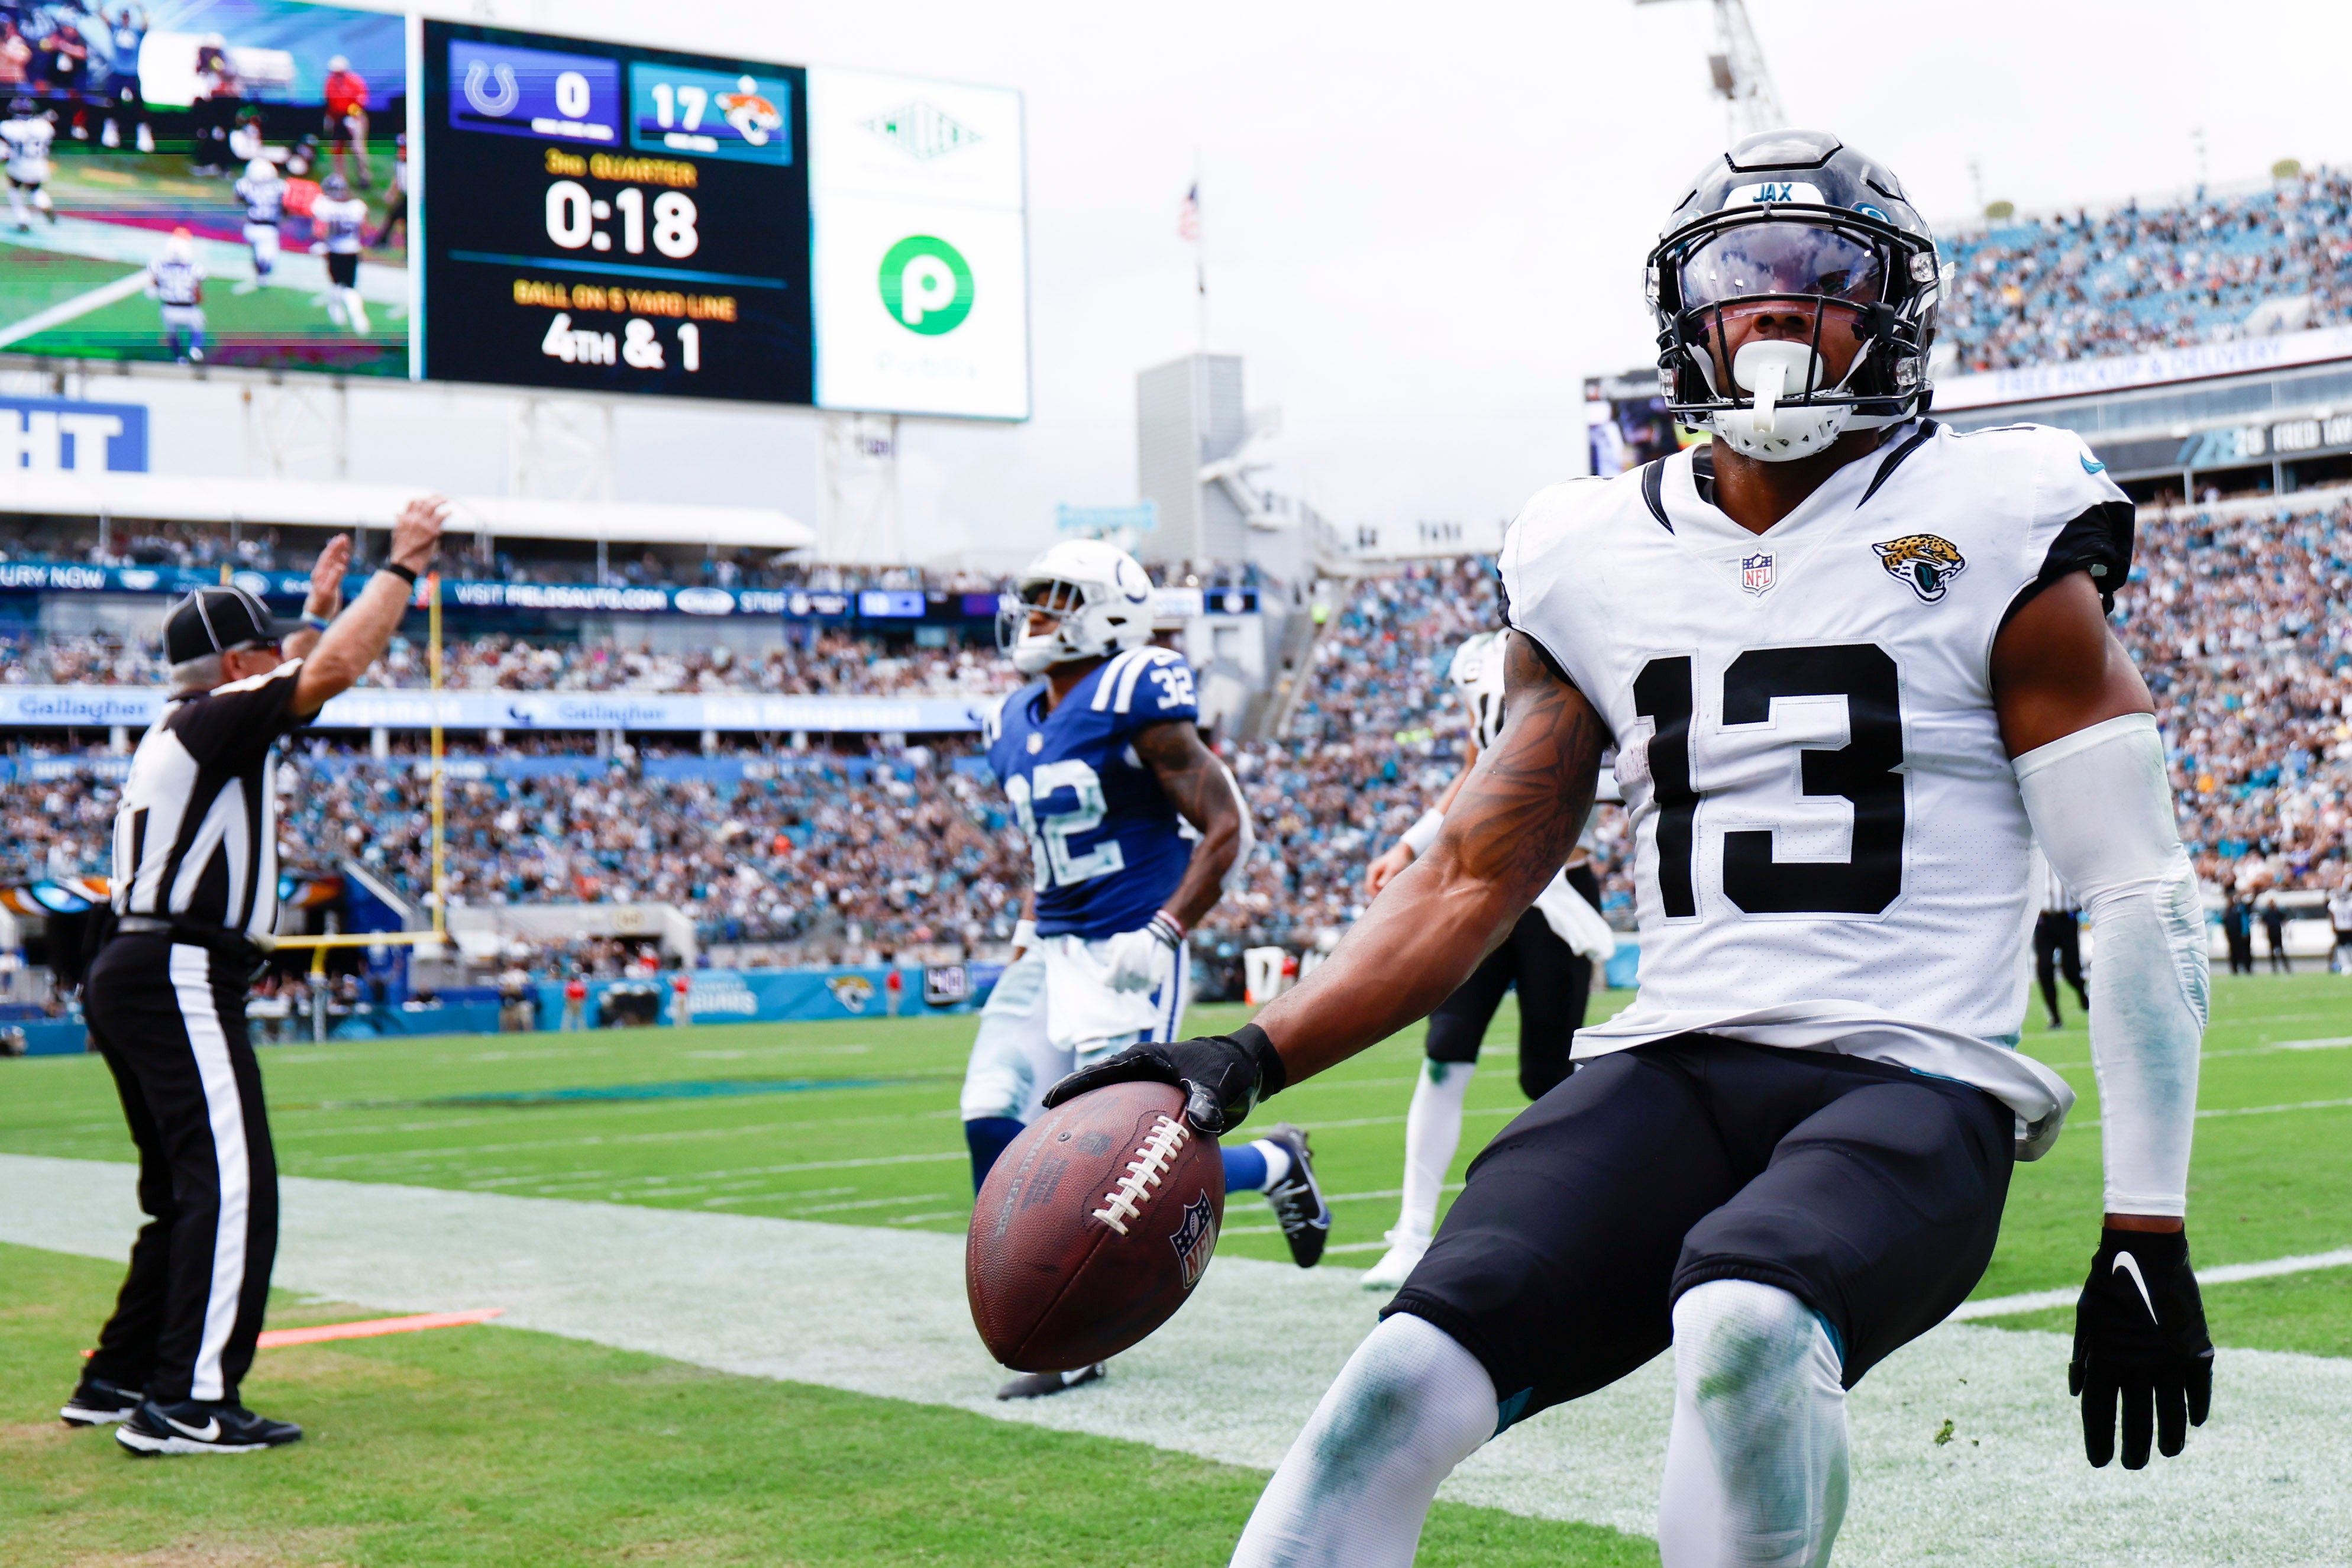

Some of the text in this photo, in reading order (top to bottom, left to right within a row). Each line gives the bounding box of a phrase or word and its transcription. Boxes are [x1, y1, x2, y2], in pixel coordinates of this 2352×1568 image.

[555, 70, 590, 118] 0
[651, 83, 708, 131] 17
[590, 153, 698, 189] QUARTER
[1752, 183, 1792, 202] JAX
[545, 180, 699, 258] 0:18
[513, 279, 572, 308] BALL
[572, 283, 608, 311] ON
[626, 288, 687, 318] YARD
[687, 293, 738, 322] LINE
[542, 312, 700, 373] 4TH & 1
[50, 566, 106, 590] NOW
[454, 583, 503, 606] VISIT
[1745, 568, 1771, 587] NFL
[18, 694, 149, 722] Gallagher
[1149, 667, 1196, 710] 32
[1633, 642, 1905, 918] 13
[1185, 1225, 1214, 1281] NFL
